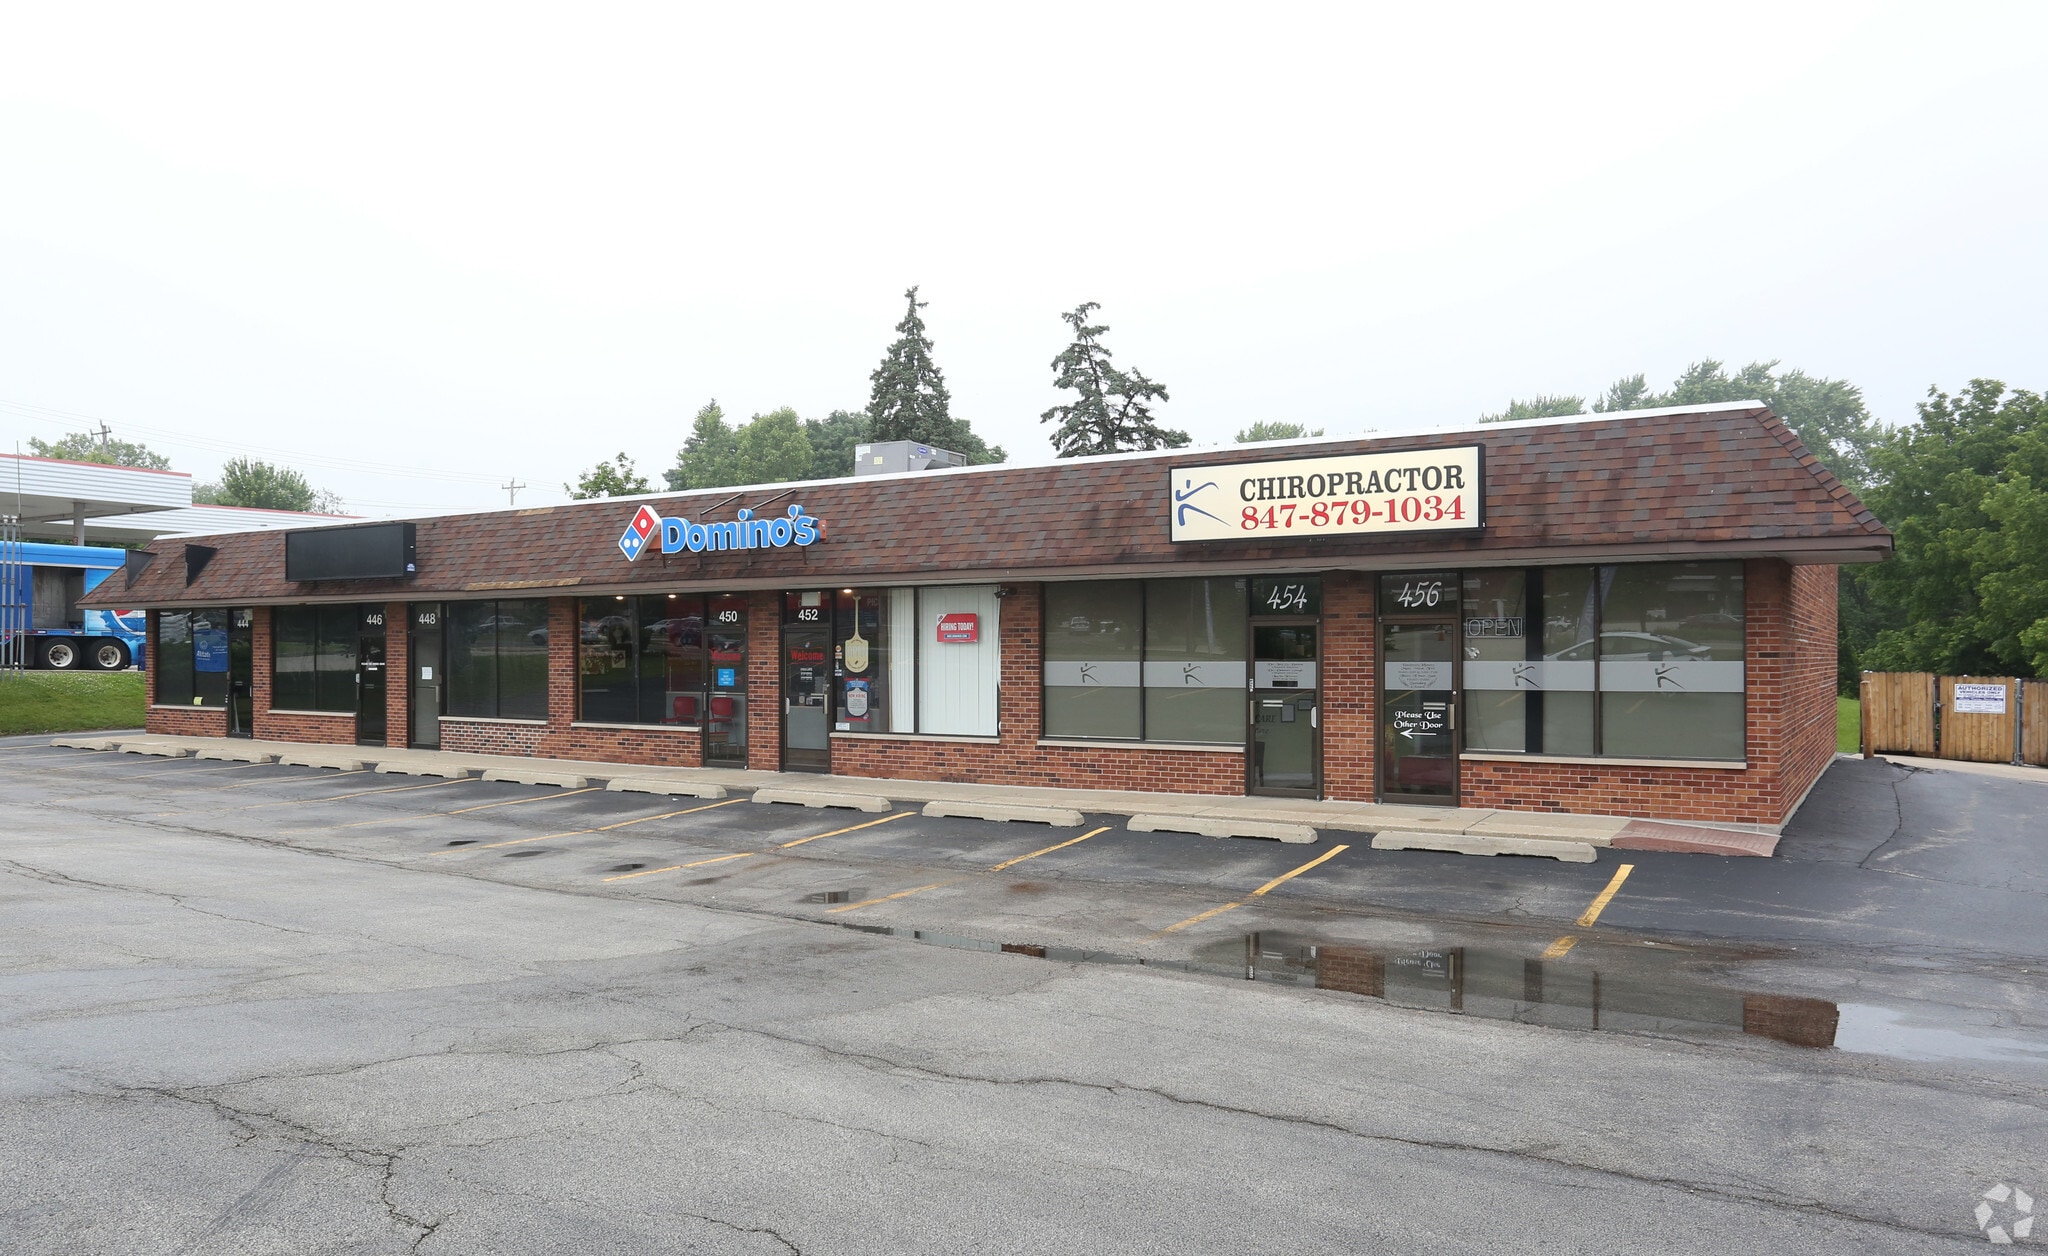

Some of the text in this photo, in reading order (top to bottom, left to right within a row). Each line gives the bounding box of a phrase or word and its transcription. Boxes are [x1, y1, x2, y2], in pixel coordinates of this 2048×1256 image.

[1239, 464, 1466, 501] CHIROPRACTOR
[1240, 495, 1466, 530] 847-879-1034
[661, 504, 820, 554] Domino's
[1267, 584, 1308, 610] 454
[1397, 581, 1442, 608] 456
[366, 614, 383, 625] 446
[418, 613, 436, 625] 448
[719, 611, 738, 622] 450
[798, 608, 818, 621] 452
[237, 619, 249, 628] 444
[940, 622, 974, 631] HIRING TODAY!
[1467, 618, 1520, 637] OPEN
[791, 649, 824, 661] Welcome
[1394, 710, 1442, 720] Please Use
[1393, 720, 1443, 730] Other Door
